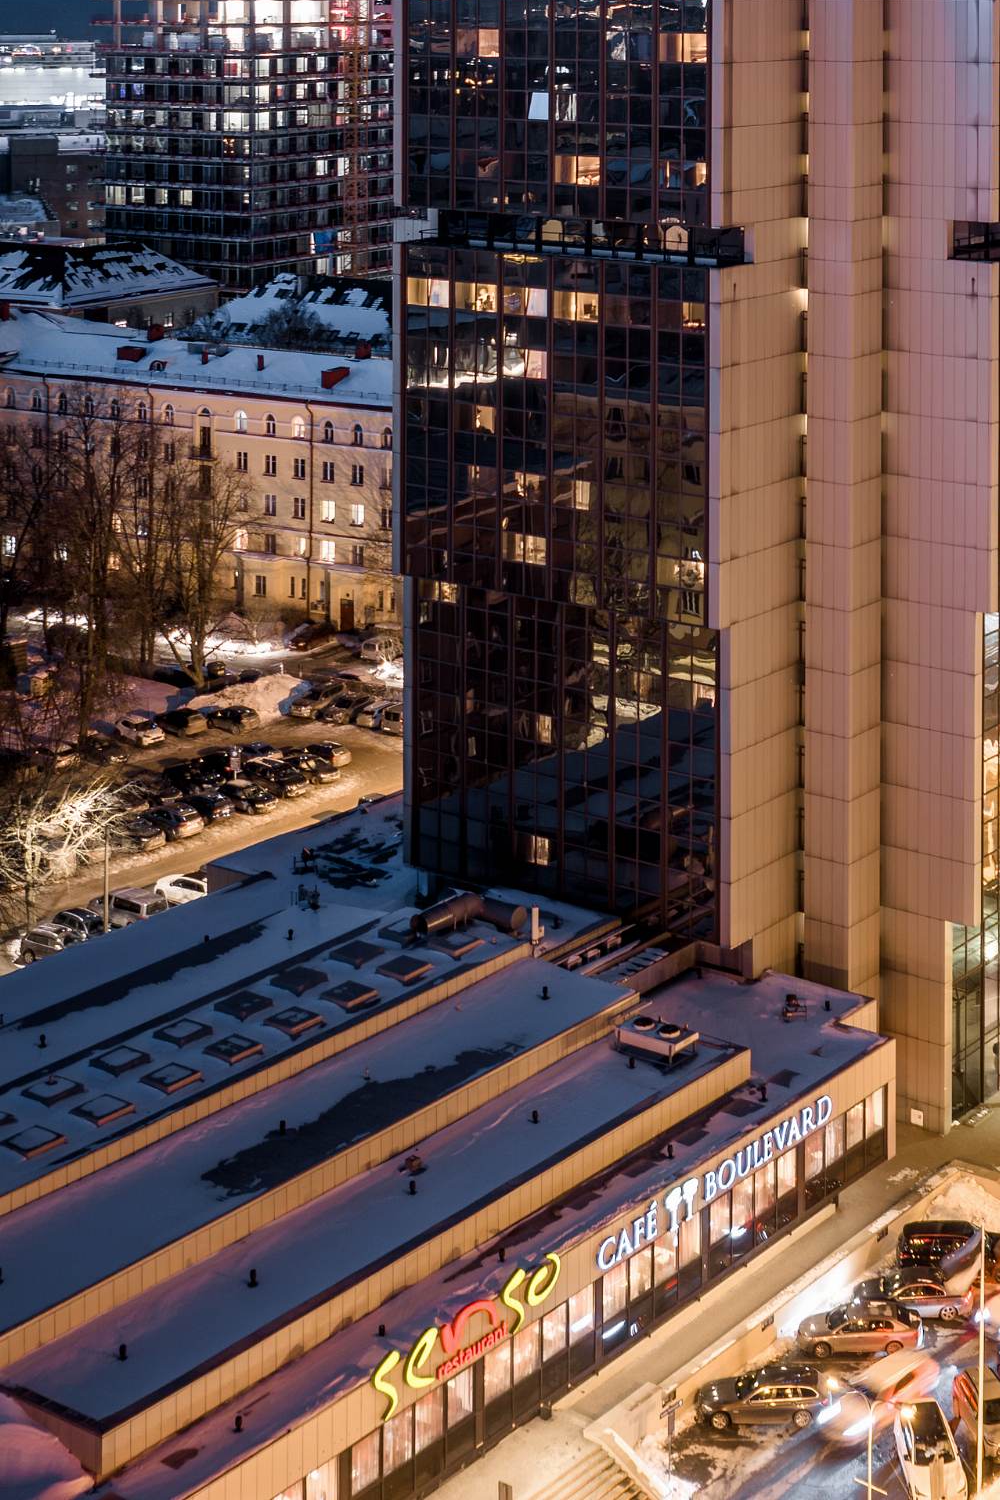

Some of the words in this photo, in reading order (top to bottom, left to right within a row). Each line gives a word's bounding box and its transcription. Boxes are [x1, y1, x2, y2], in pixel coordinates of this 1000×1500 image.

[596, 1200, 659, 1271] CAFÉ
[704, 1095, 833, 1203] BOULEVARD
[372, 1252, 561, 1422] senso
[436, 1320, 509, 1381] restaurant
